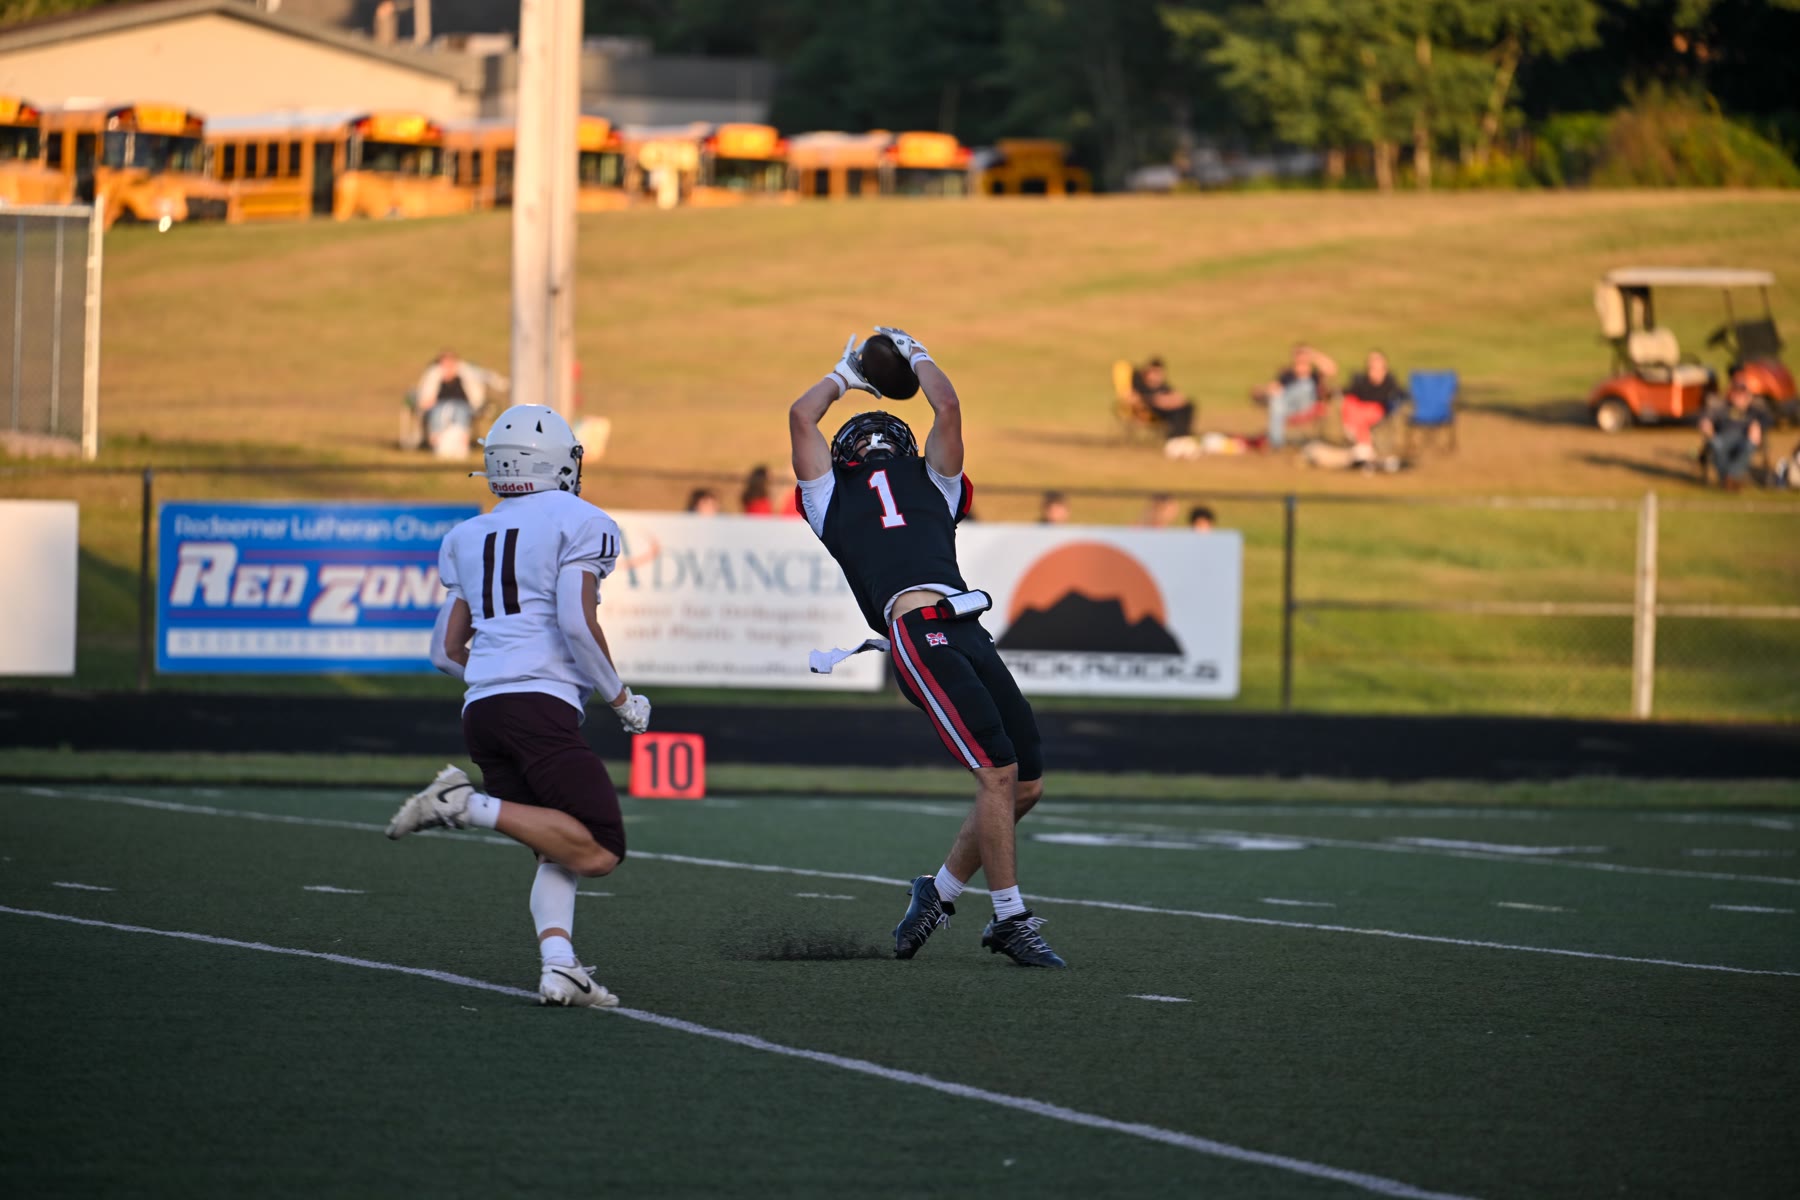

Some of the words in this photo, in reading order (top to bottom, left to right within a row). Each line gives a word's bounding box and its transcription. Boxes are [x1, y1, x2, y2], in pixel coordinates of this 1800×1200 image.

[492, 481, 534, 492] Riddell
[867, 469, 907, 528] 1
[174, 514, 288, 540] Redeemer
[290, 514, 391, 542] Lutheran
[601, 532, 615, 558] 11
[482, 528, 520, 619] 11
[643, 741, 693, 790] 10
